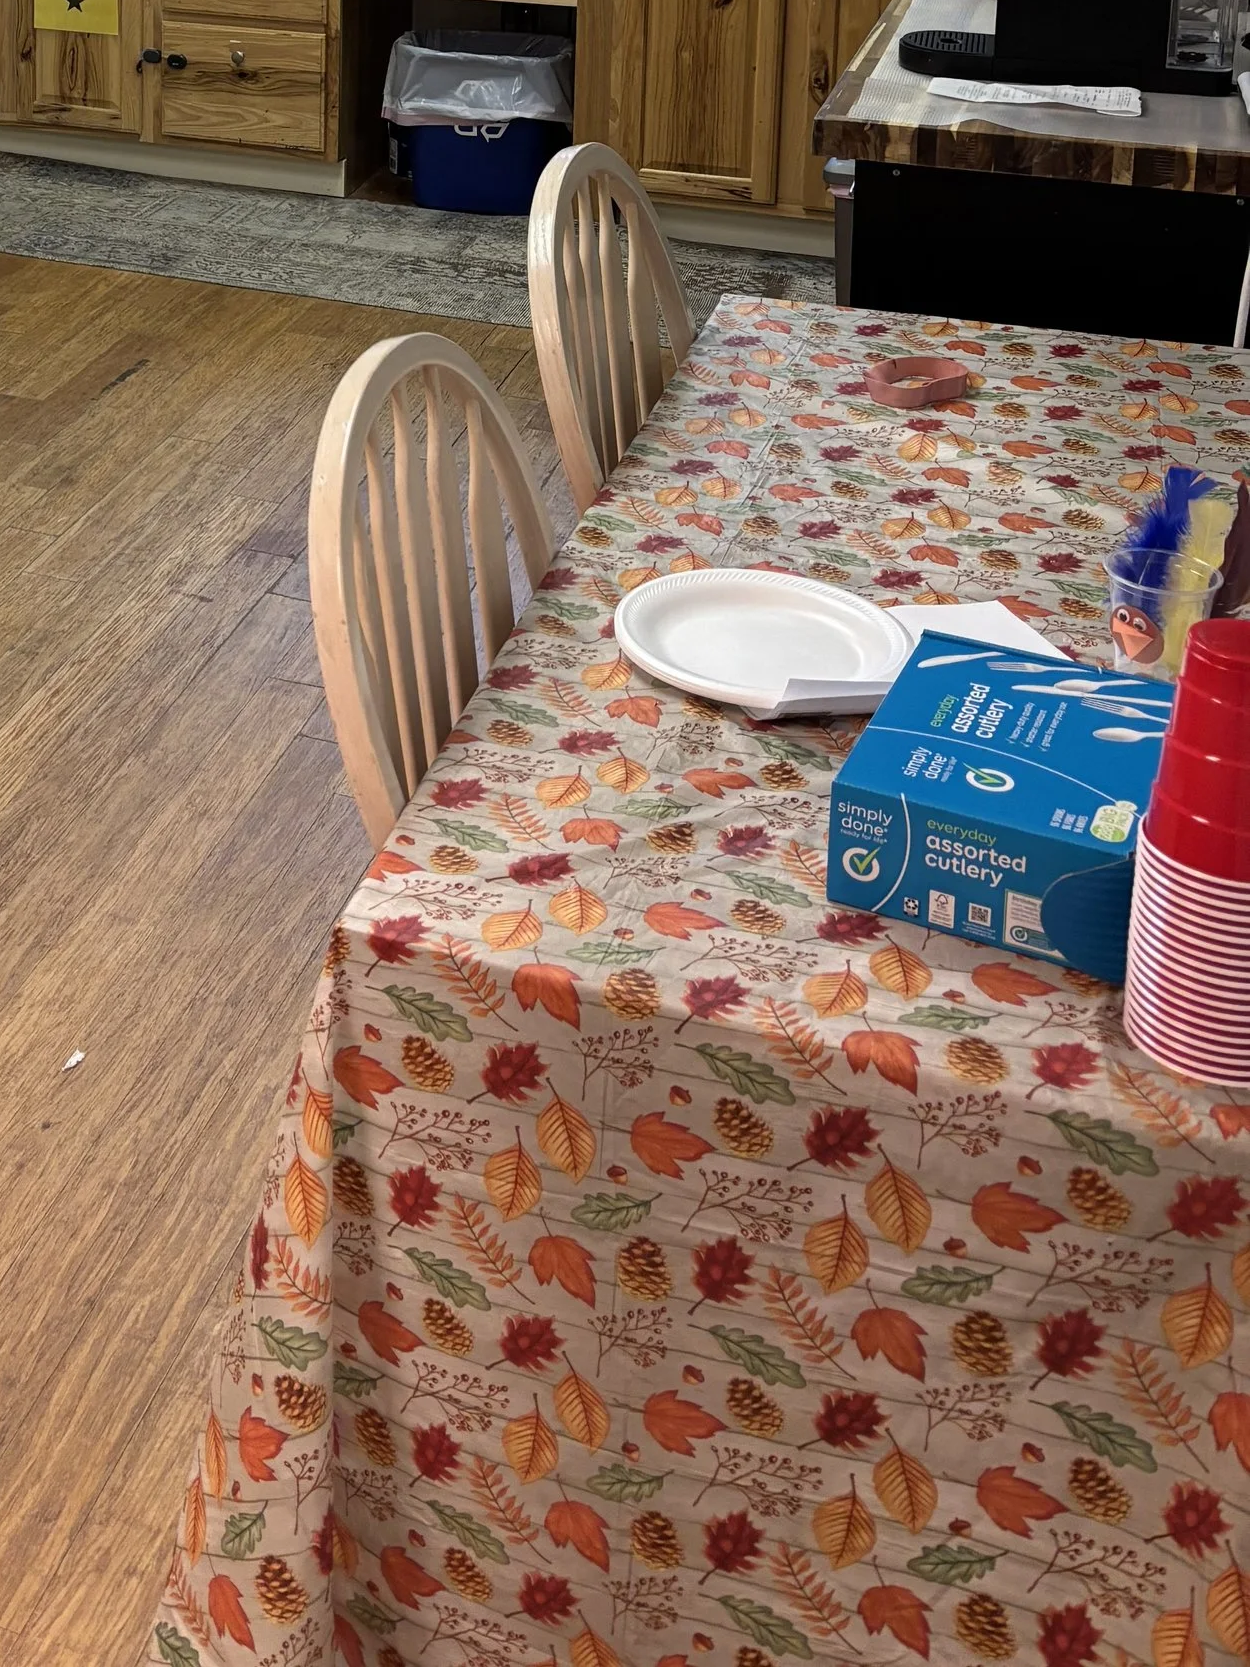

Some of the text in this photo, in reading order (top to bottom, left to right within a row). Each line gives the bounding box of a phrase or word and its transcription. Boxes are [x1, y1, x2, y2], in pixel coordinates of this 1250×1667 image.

[930, 694, 960, 728] everyday
[951, 683, 991, 733] assorted
[976, 699, 1014, 739] cutlery
[903, 747, 933, 778] simply
[838, 801, 893, 826] simply
[927, 818, 997, 847] everyday
[925, 853, 1003, 888] cutlery
[926, 834, 1027, 874] assorted
